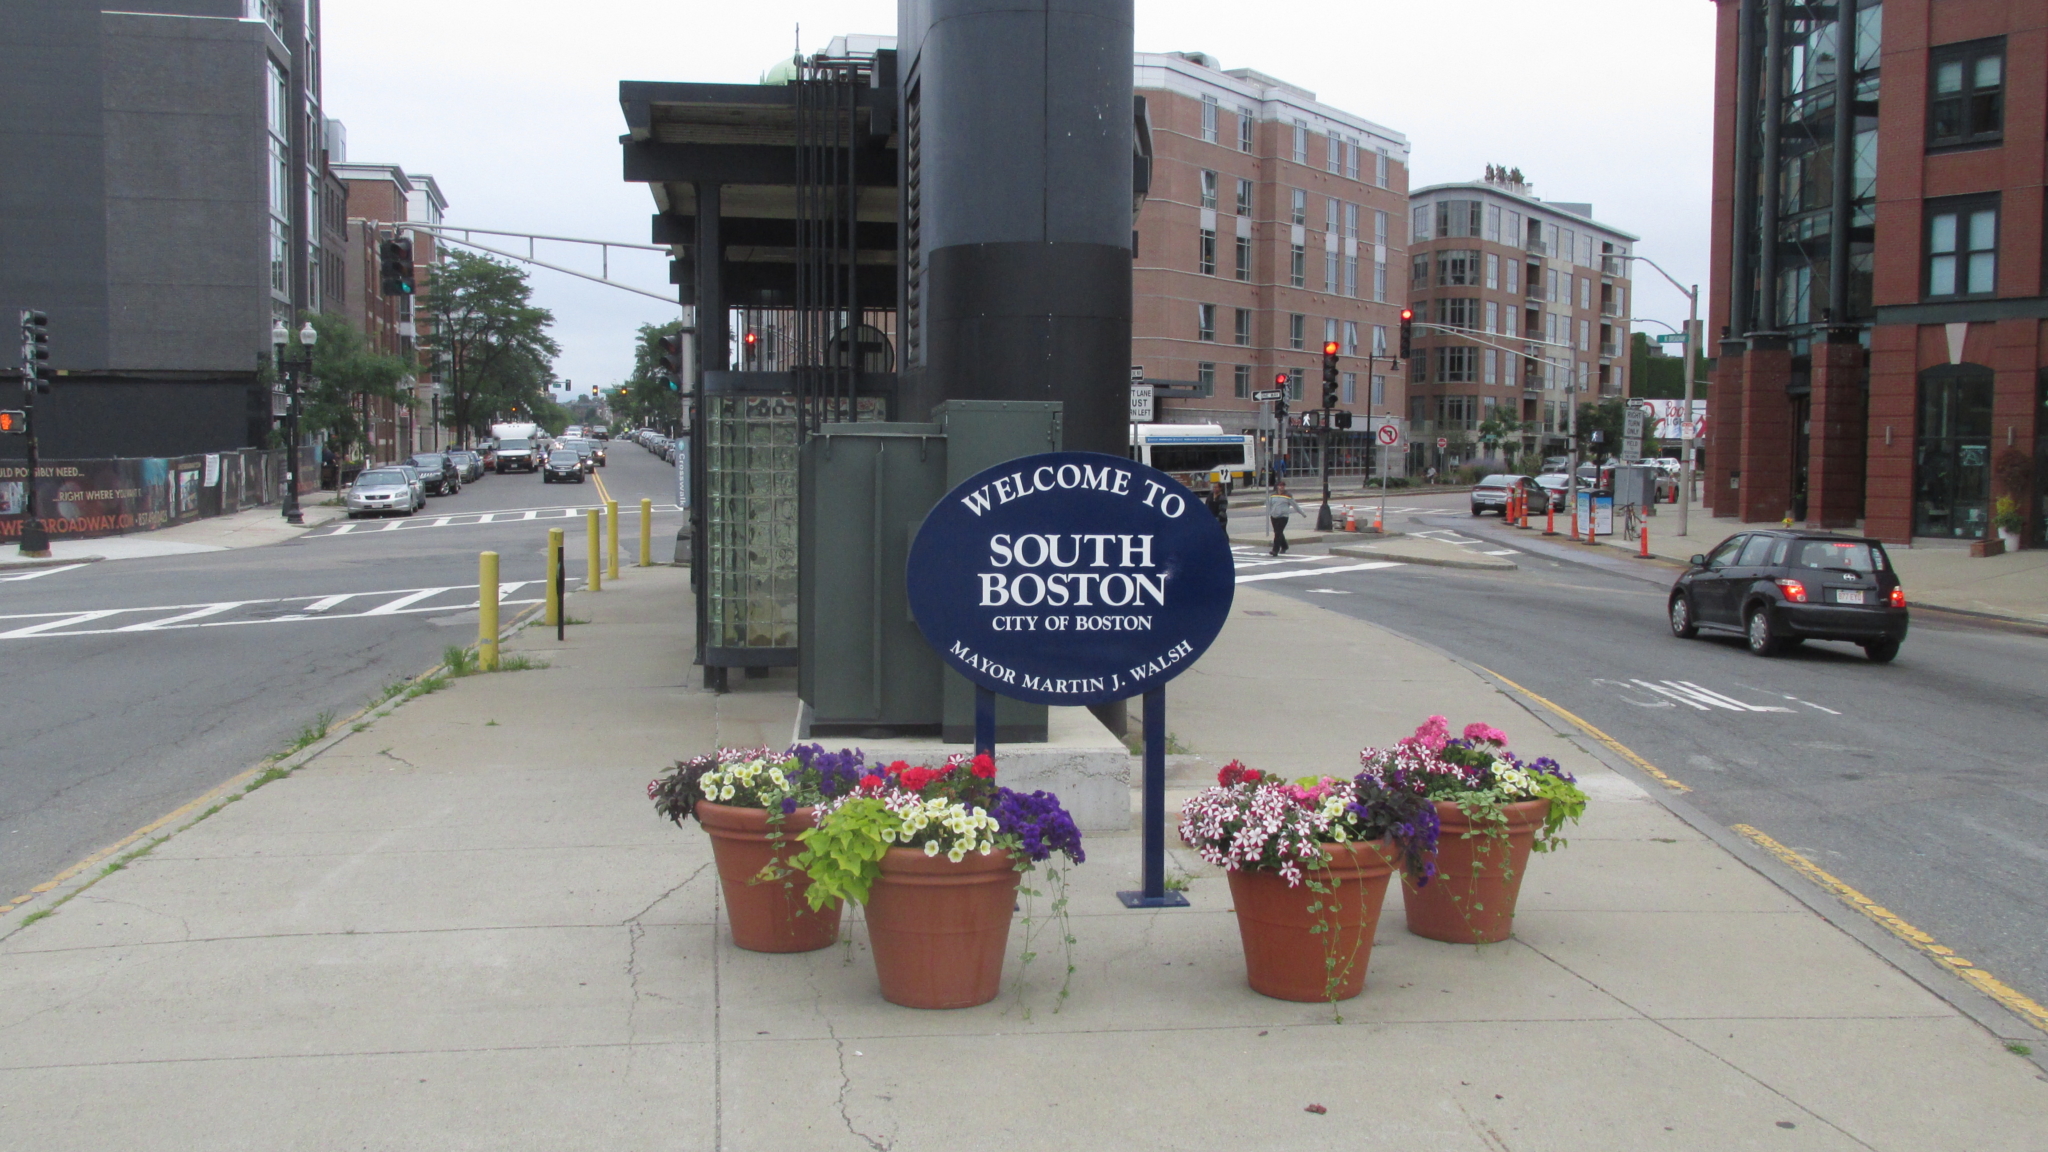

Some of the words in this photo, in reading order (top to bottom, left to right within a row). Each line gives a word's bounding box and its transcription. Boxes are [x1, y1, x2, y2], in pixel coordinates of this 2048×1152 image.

[1131, 399, 1148, 407] UST
[1627, 411, 1641, 419] RIGHT
[1626, 427, 1639, 435] ONLY
[678, 453, 687, 507] Crosswalk
[961, 464, 1131, 517] WELCOME
[1142, 480, 1186, 518] TO
[85, 489, 114, 500] WHERE
[990, 534, 1155, 567] SOUTH
[978, 573, 1168, 606] BOSTON
[992, 616, 1039, 631] CITY
[1045, 616, 1070, 631] OF
[1075, 616, 1153, 631] BOSTON
[950, 640, 1016, 684] MAYOR
[1022, 674, 1104, 694] MARTIN
[1112, 674, 1126, 692] J.
[1130, 639, 1193, 681] WALSH
